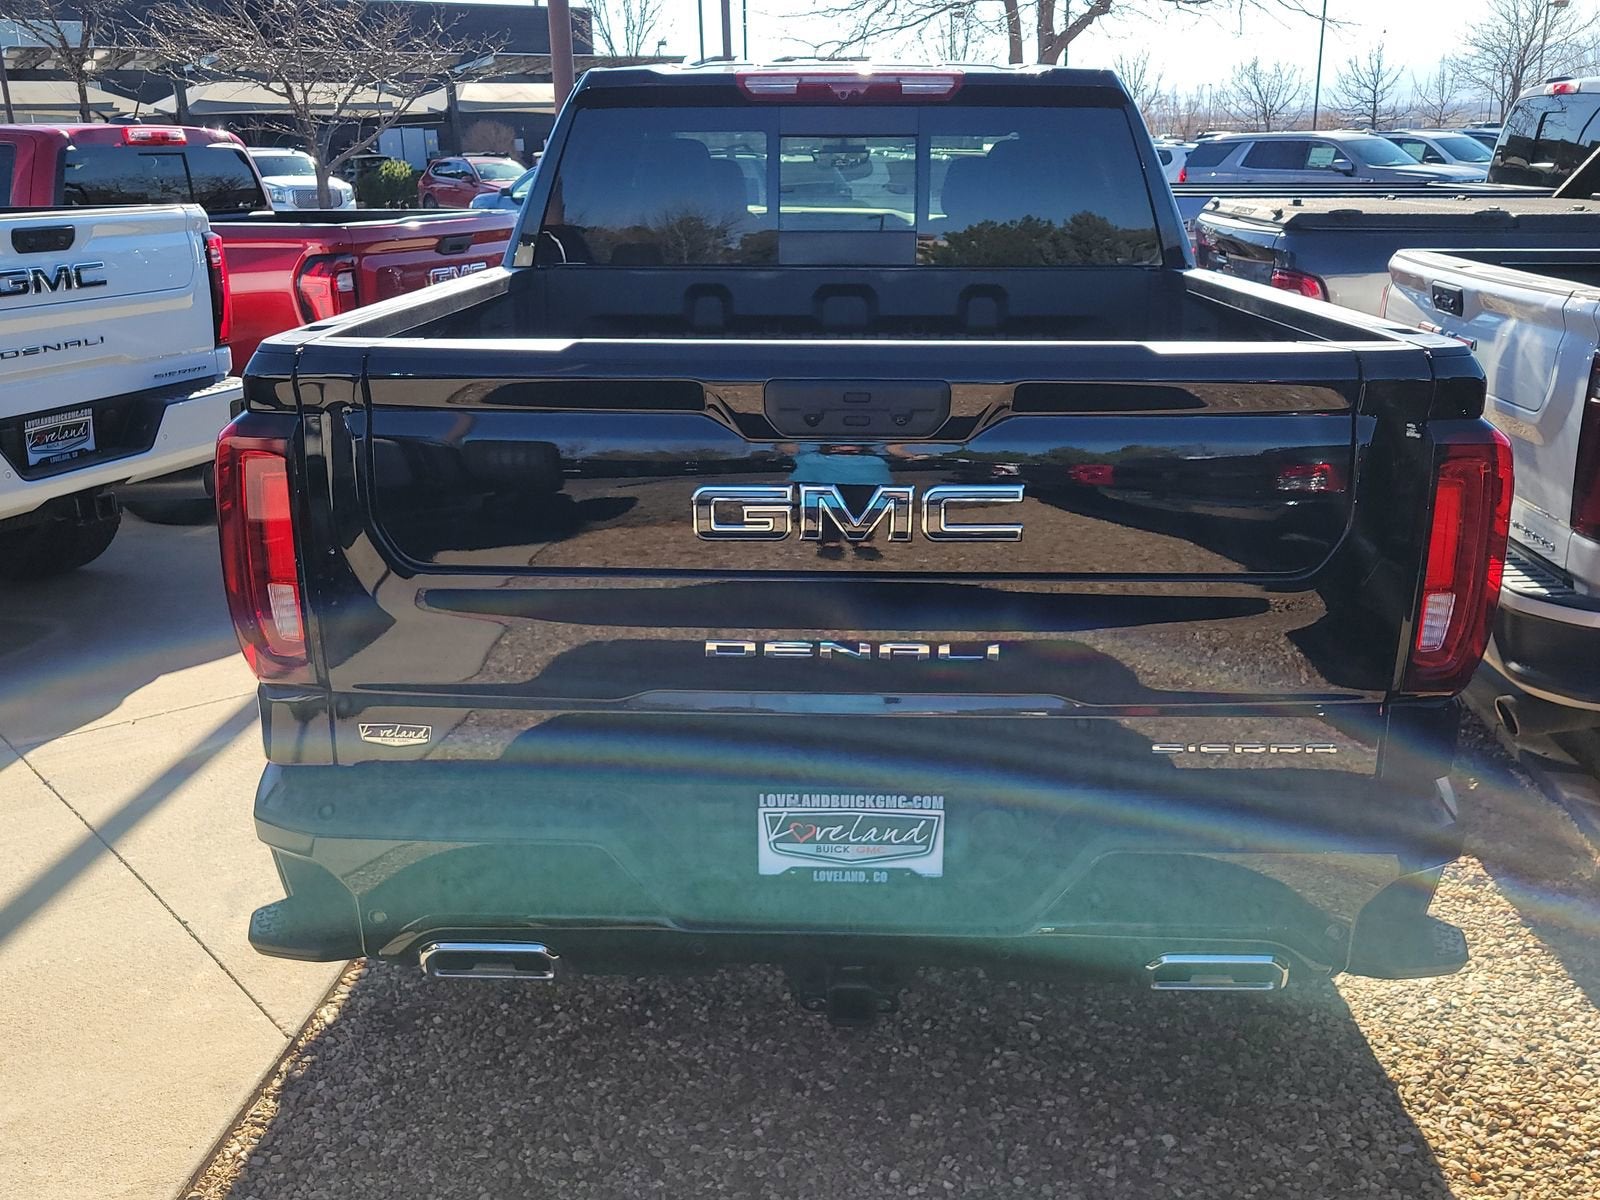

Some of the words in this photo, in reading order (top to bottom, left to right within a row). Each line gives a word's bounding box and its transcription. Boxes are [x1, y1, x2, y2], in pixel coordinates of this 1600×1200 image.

[0, 262, 107, 297] GMC
[0, 336, 104, 360] DENALI
[692, 484, 1025, 541] GMC
[705, 639, 999, 661] DENALI
[361, 724, 428, 738] Lveland
[1151, 743, 1337, 754] SIERRA
[759, 794, 944, 809] LOVELANDBUICKGMC.COM
[769, 812, 928, 844] Loveland
[815, 845, 850, 854] BUICK
[855, 846, 886, 854] GMC
[813, 870, 869, 883] LOVELAND,
[873, 871, 888, 882] CO
